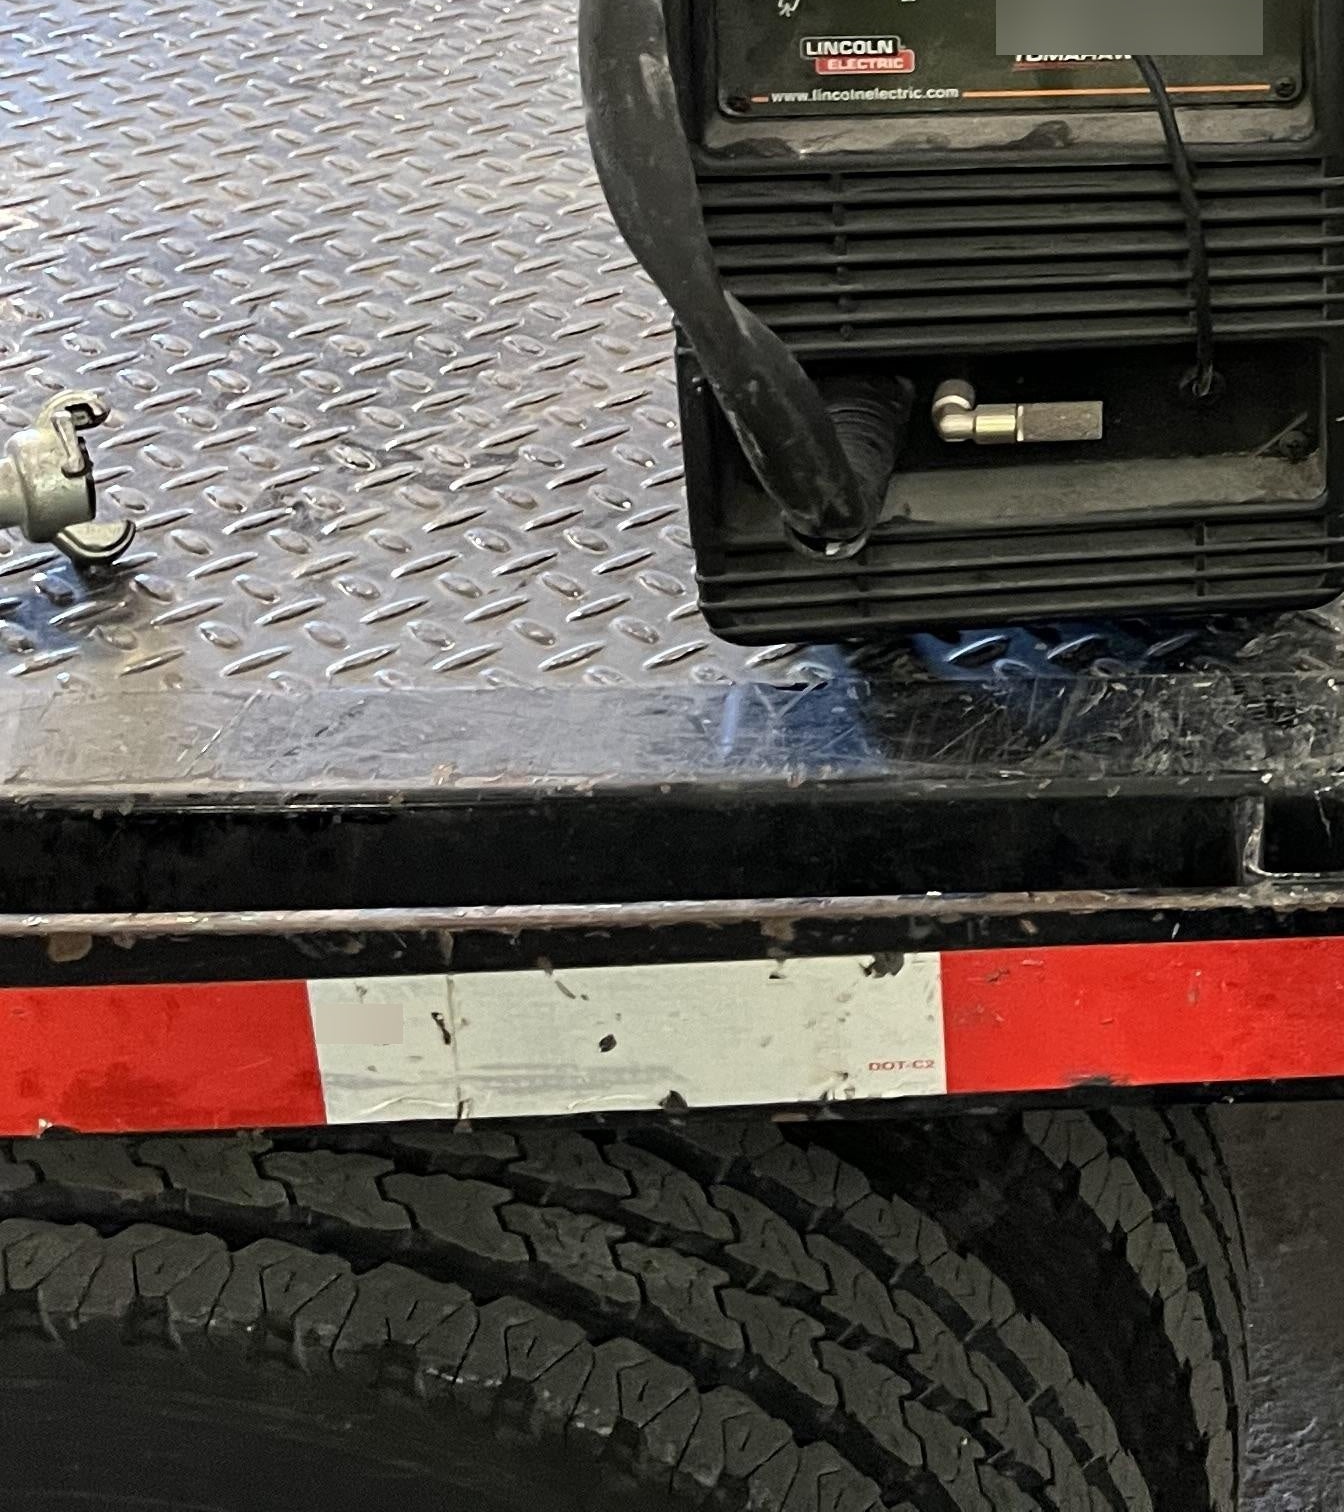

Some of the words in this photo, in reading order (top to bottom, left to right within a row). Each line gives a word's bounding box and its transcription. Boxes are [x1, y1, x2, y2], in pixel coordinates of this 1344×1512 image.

[806, 39, 893, 56] LINCOLN
[827, 57, 904, 71] ELECTRIC
[771, 86, 959, 103] www.lincolnelectric.com
[868, 1059, 934, 1071] DOT-C2
